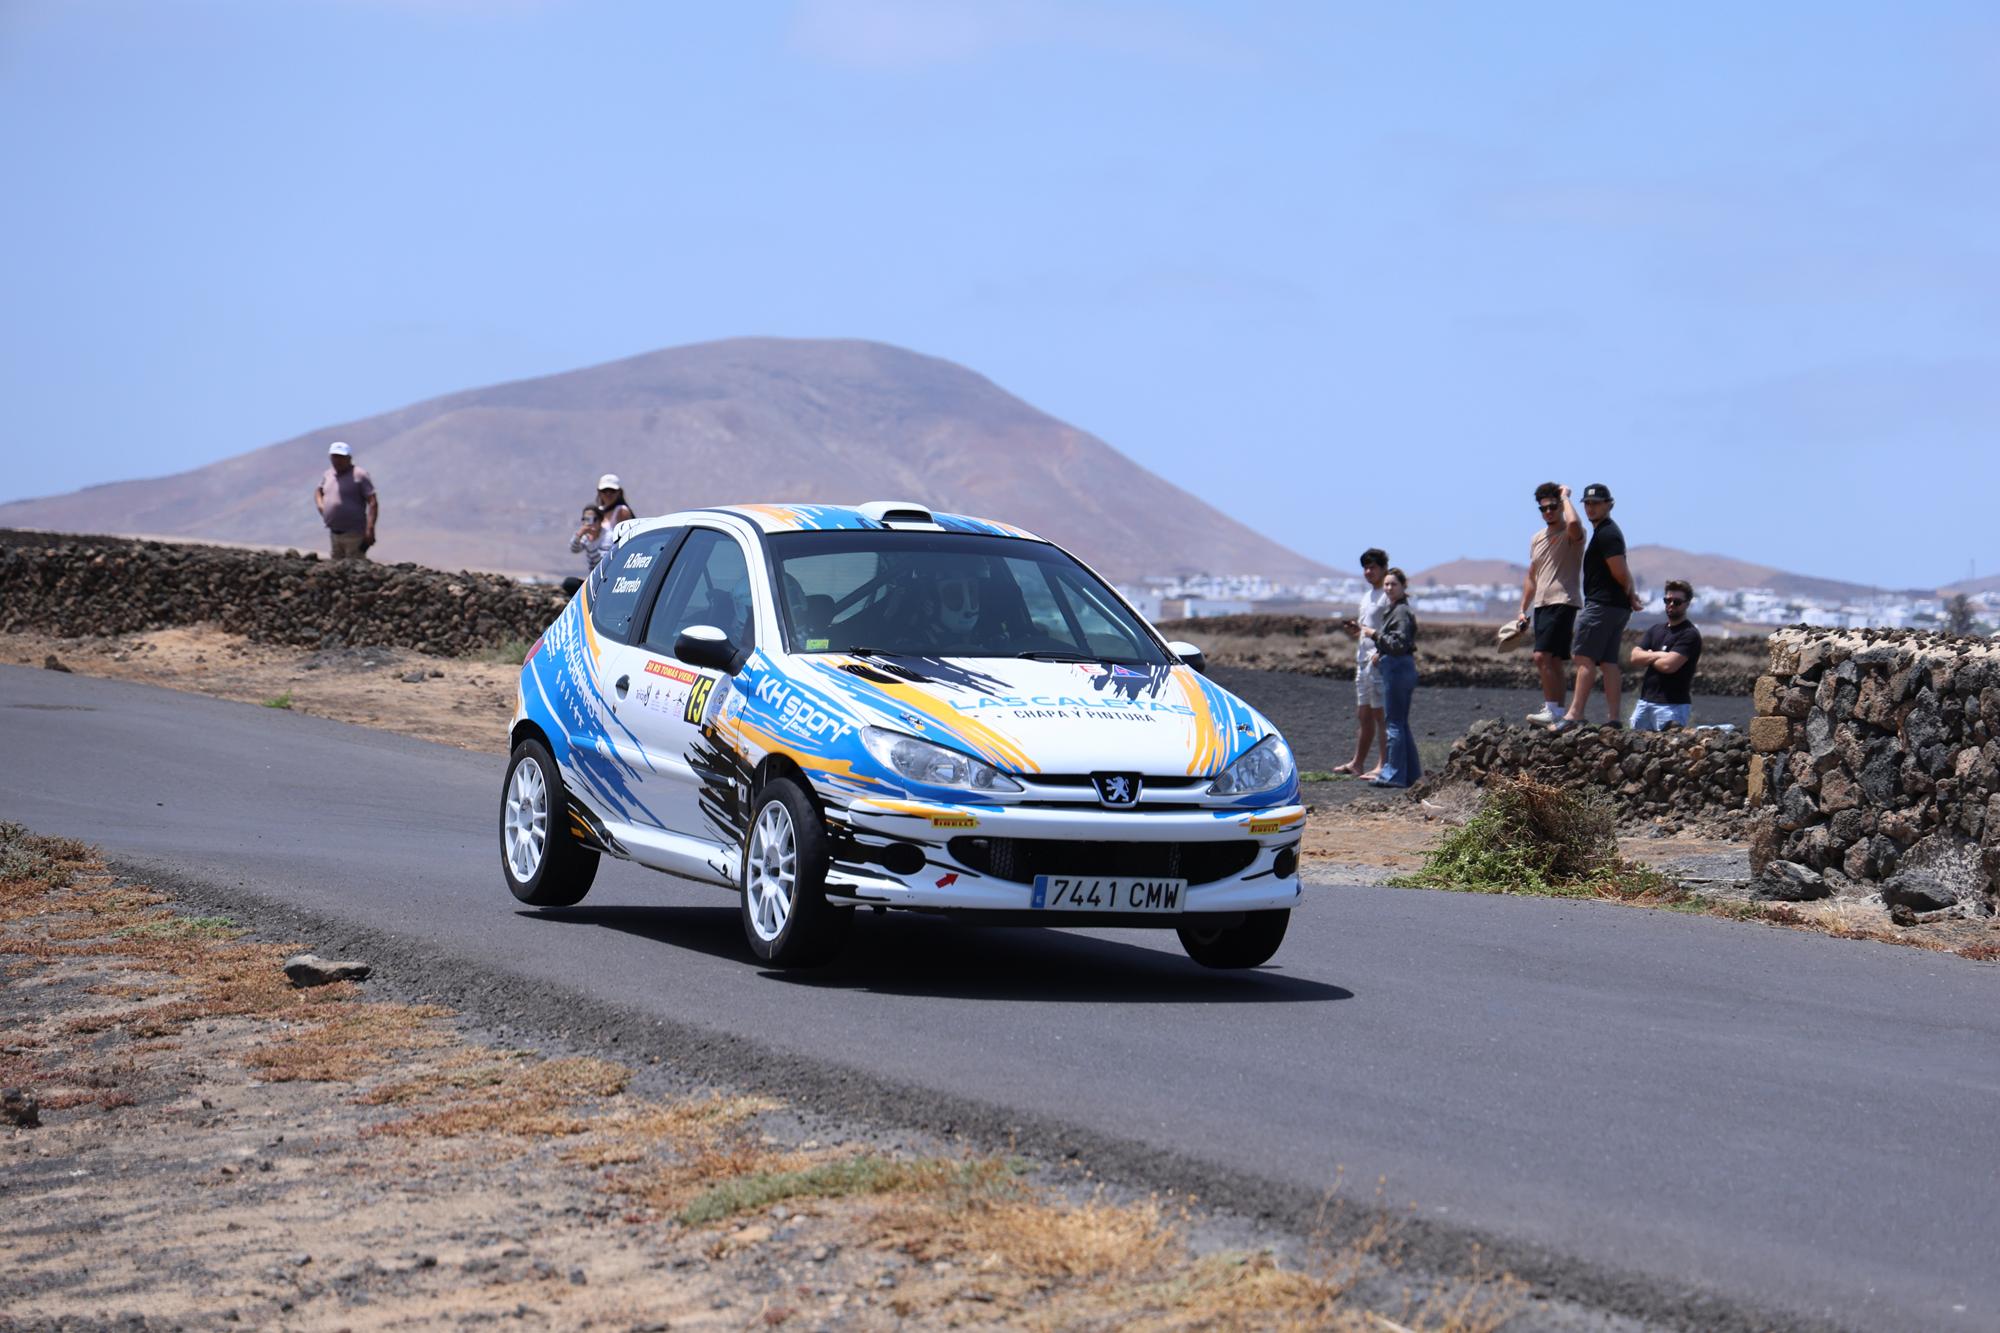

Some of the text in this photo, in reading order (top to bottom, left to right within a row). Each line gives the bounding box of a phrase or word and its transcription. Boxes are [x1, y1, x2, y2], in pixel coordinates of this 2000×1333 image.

[624, 553, 652, 568] R.Rivera
[612, 577, 641, 592] T.Barreto
[755, 674, 791, 710] KH
[687, 677, 713, 723] 15
[1013, 710, 1156, 723] CHAPA Y PINTURA
[933, 817, 974, 827] PIRELLI
[1250, 823, 1278, 833] PIRELLI
[1052, 880, 1179, 909] 7441 CMW
